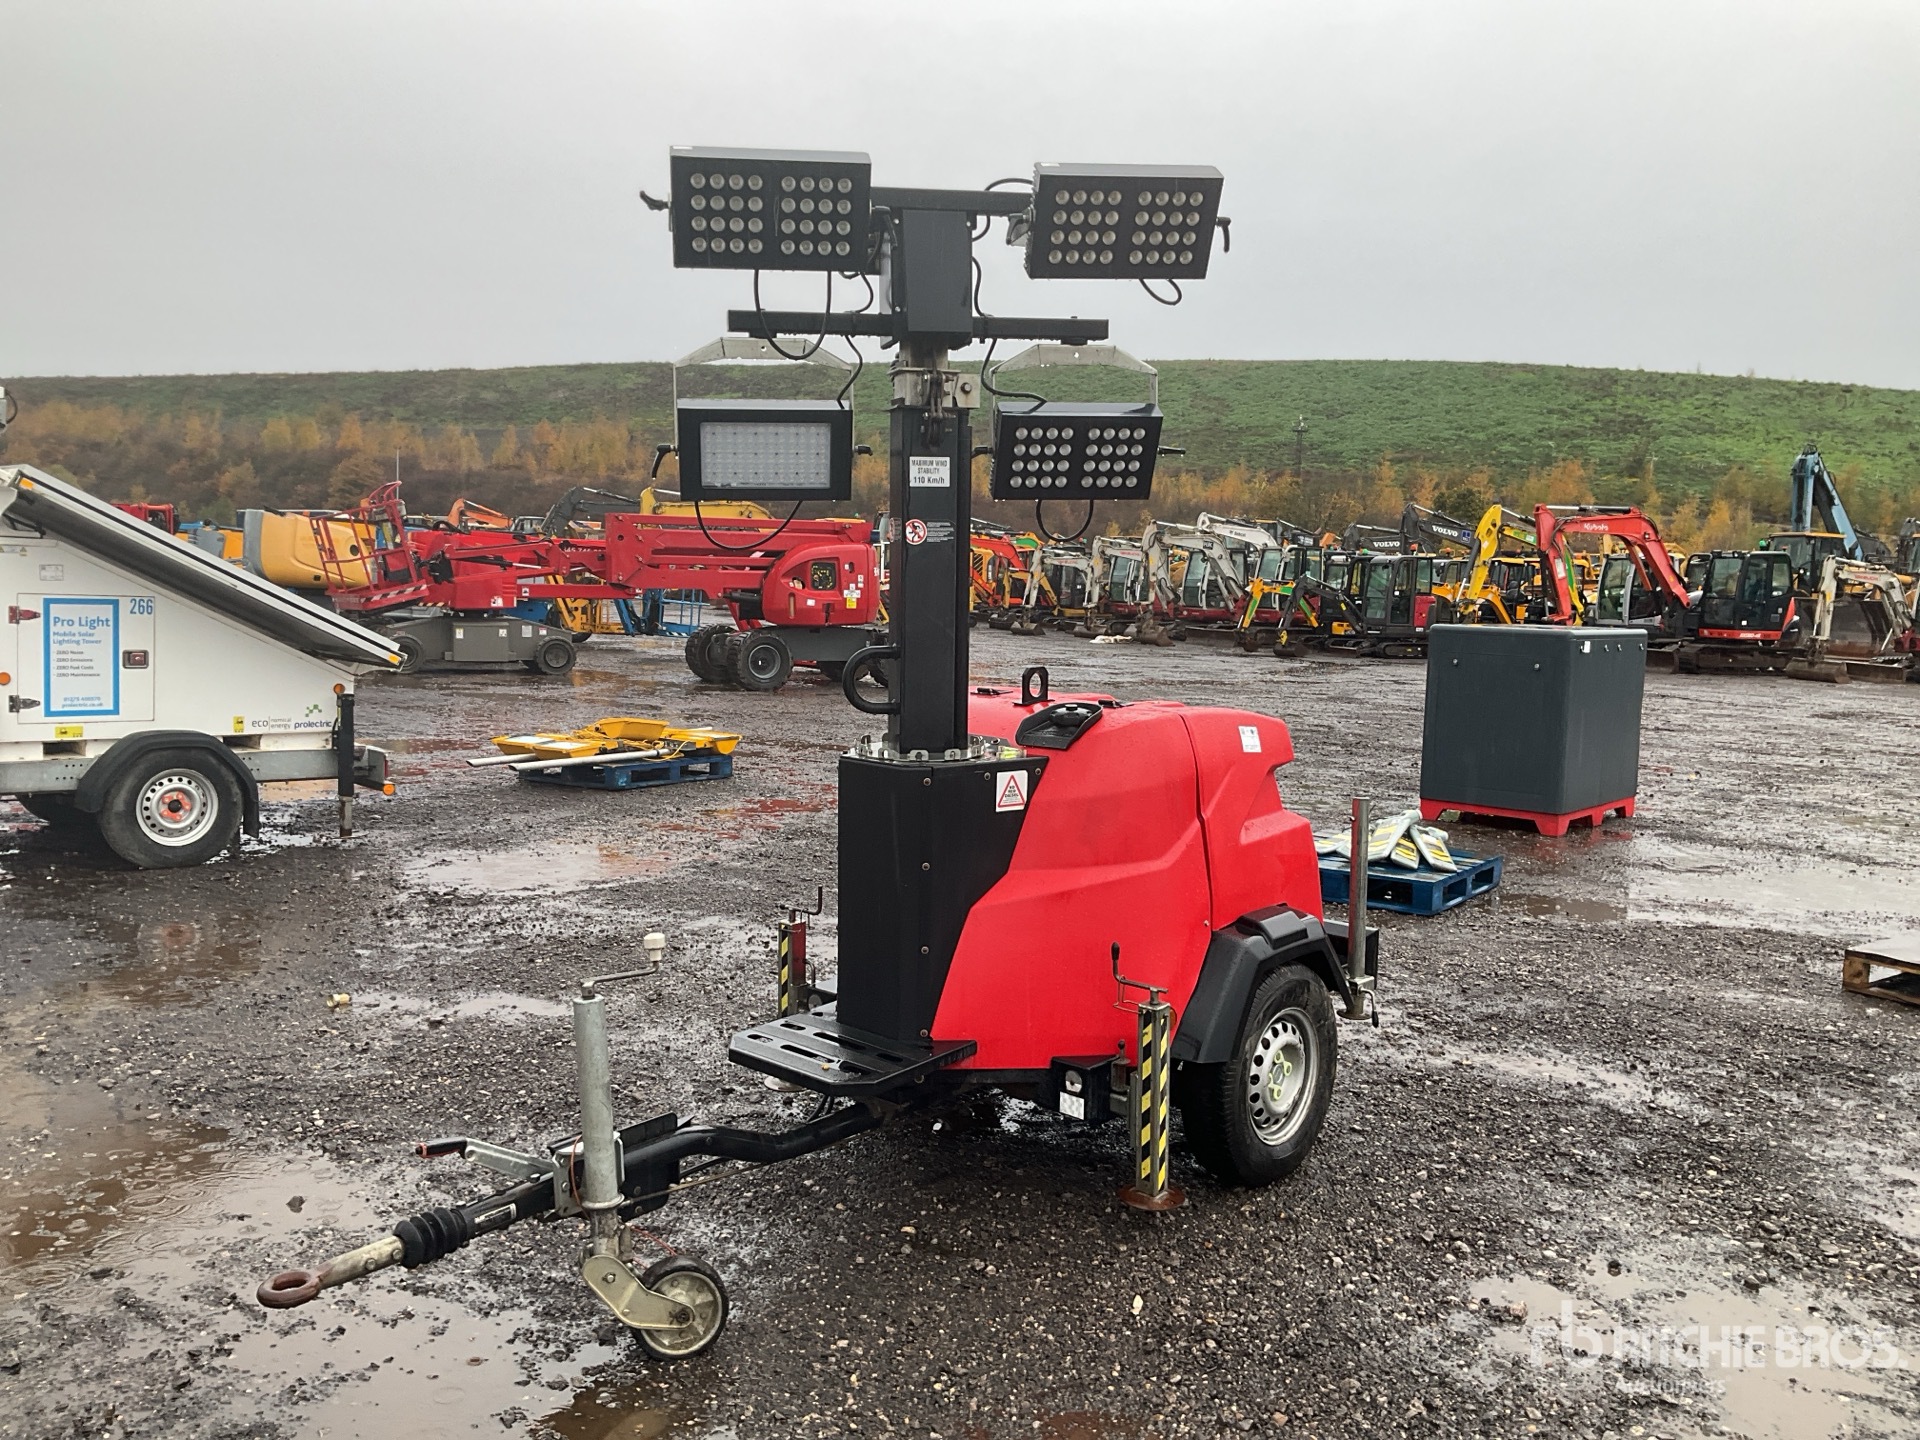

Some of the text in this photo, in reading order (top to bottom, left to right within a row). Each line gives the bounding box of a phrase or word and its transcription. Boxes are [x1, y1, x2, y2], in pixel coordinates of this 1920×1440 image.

[913, 476, 945, 484] 110 Km/h
[1431, 525, 1459, 537] VOLVO
[1583, 522, 1609, 531] Kubota
[129, 598, 153, 615] 266
[53, 616, 111, 630] Pro Light
[52, 638, 80, 646] Lighting
[251, 720, 269, 728] eco
[294, 720, 332, 730] prolectric
